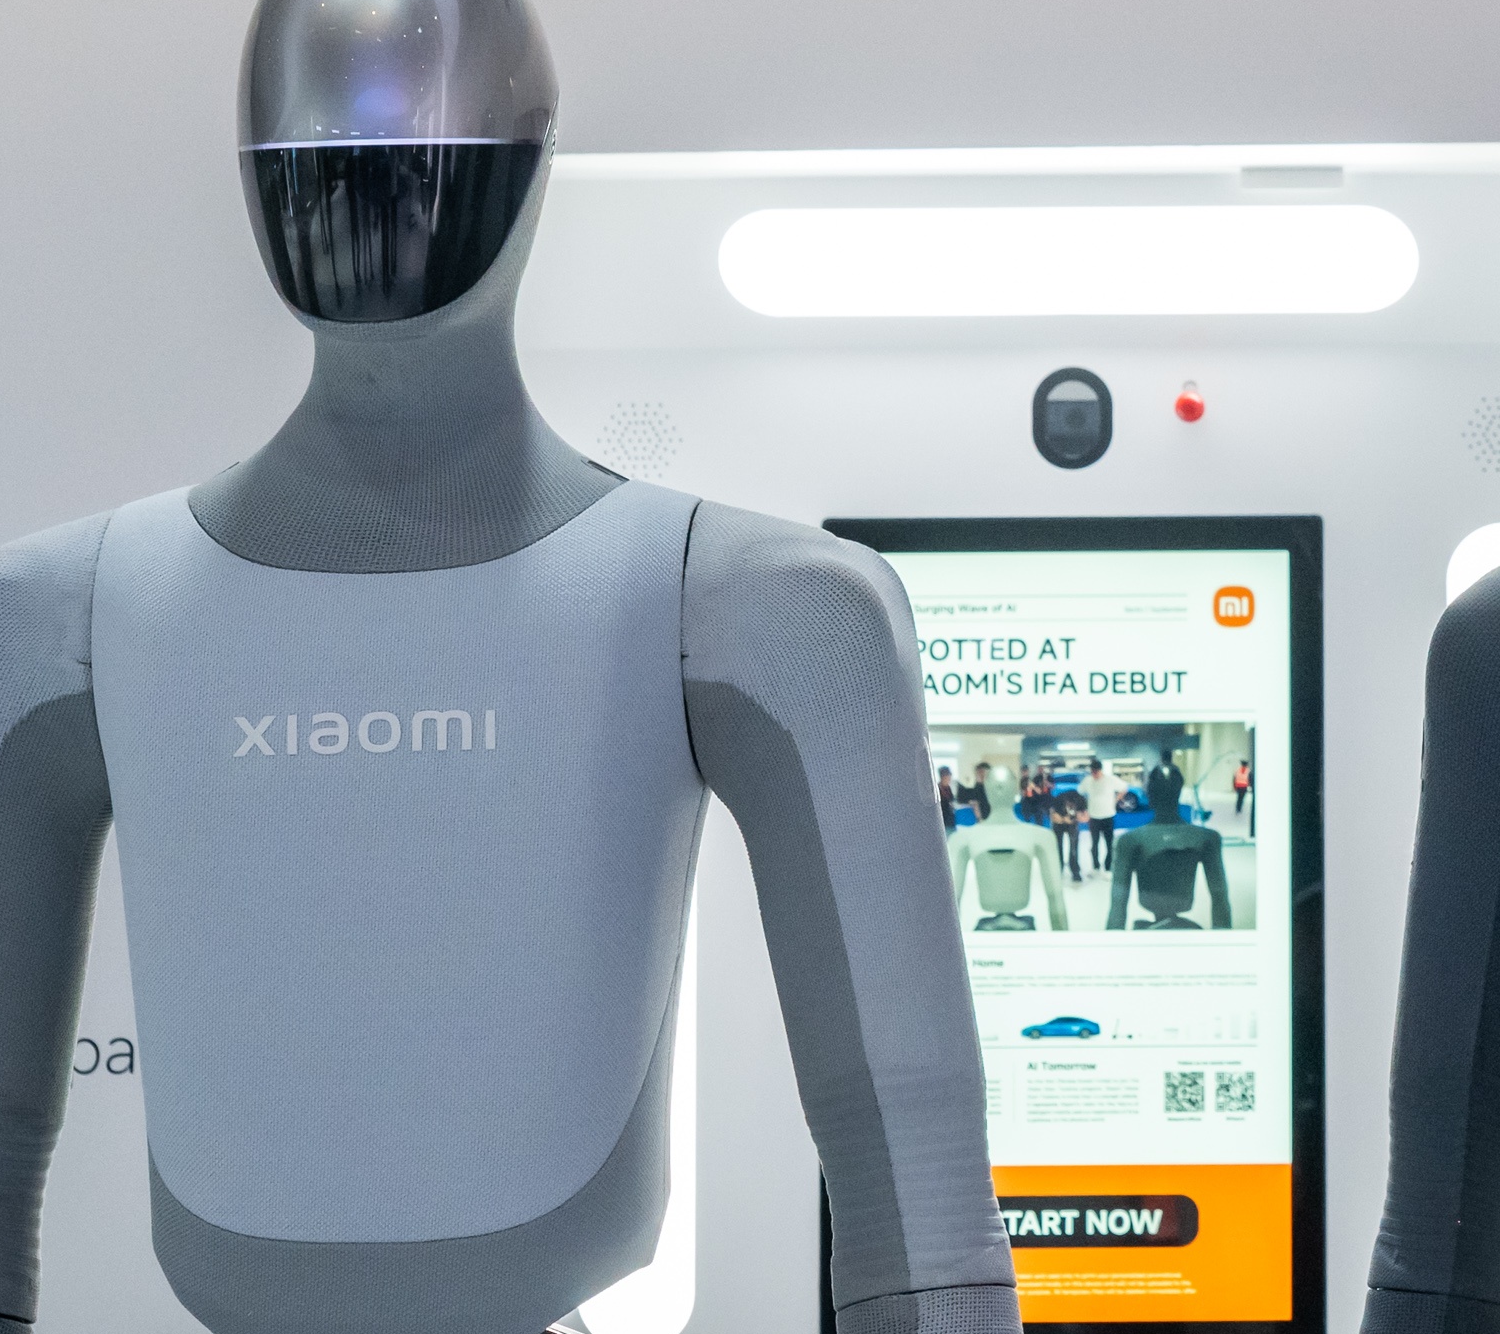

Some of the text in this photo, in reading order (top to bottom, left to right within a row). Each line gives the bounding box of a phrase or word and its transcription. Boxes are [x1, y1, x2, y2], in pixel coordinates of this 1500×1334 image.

[918, 637, 1077, 662] POTTED AT
[924, 669, 1188, 696] AOMI'S IFA DEBUT
[233, 709, 496, 757] xiaomi
[1042, 1061, 1097, 1071] Tomorrow
[1002, 1209, 1164, 1236] TART NOW
